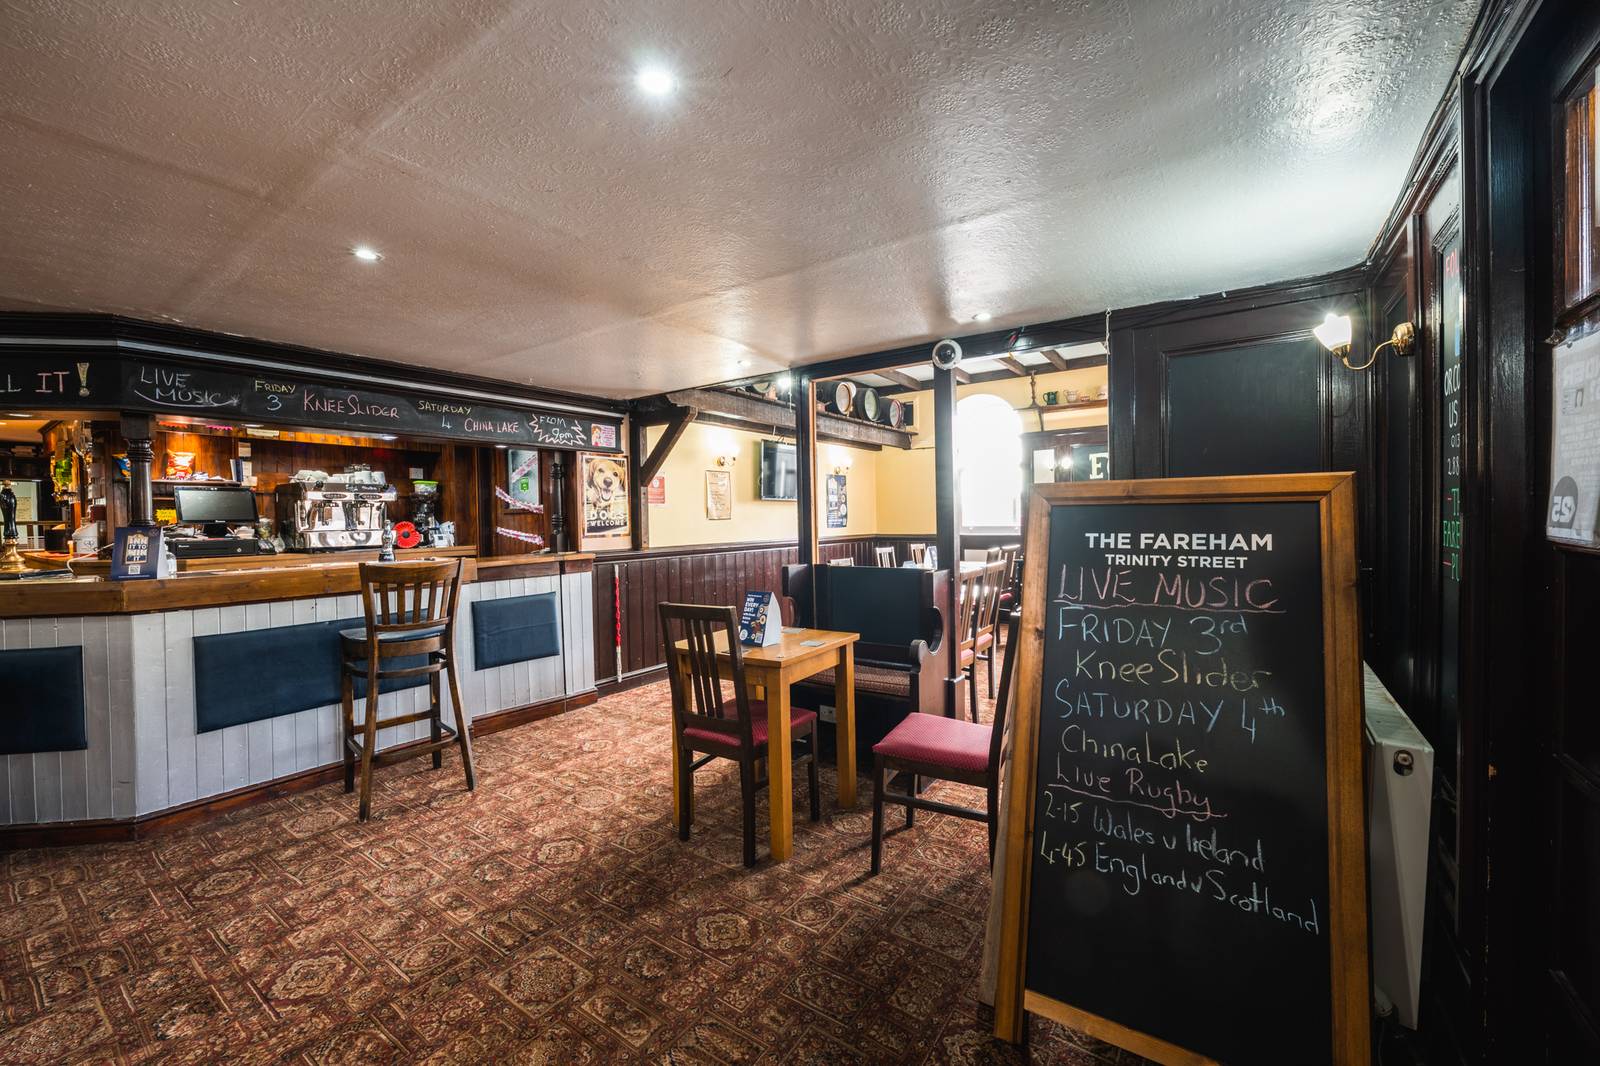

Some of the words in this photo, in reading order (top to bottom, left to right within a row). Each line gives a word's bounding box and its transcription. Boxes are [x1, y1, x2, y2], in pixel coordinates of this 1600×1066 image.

[0, 374, 21, 392] L
[140, 366, 191, 387] LIVE
[255, 380, 296, 394] FRIDAY
[156, 387, 222, 406] MUSIC
[266, 395, 282, 411] 3
[418, 401, 472, 416] SATURDAY
[441, 415, 451, 429] 4
[540, 415, 567, 428] FROM
[551, 427, 573, 440] 9pm
[590, 510, 625, 521] DOGS
[590, 519, 625, 527] WELCOME
[1085, 532, 1131, 549] THE
[1140, 533, 1273, 551] FAREHAM
[1105, 554, 1172, 567] TRINITY
[1177, 556, 1248, 569] STREET
[1057, 563, 1136, 603] LIVE
[1153, 572, 1279, 609] MUSIC
[1058, 606, 1171, 648] FRIDAY
[1190, 614, 1249, 655] 3rd
[1055, 678, 1224, 733] SATURDAY
[1241, 697, 1286, 744] 4th
[1056, 752, 1112, 793] Live
[1125, 767, 1212, 822] Rugby
[1093, 805, 1156, 845] Wales
[1162, 835, 1177, 850] v
[1186, 823, 1265, 873] Ireland
[1095, 842, 1187, 896] England
[1205, 869, 1320, 936] Scotland
